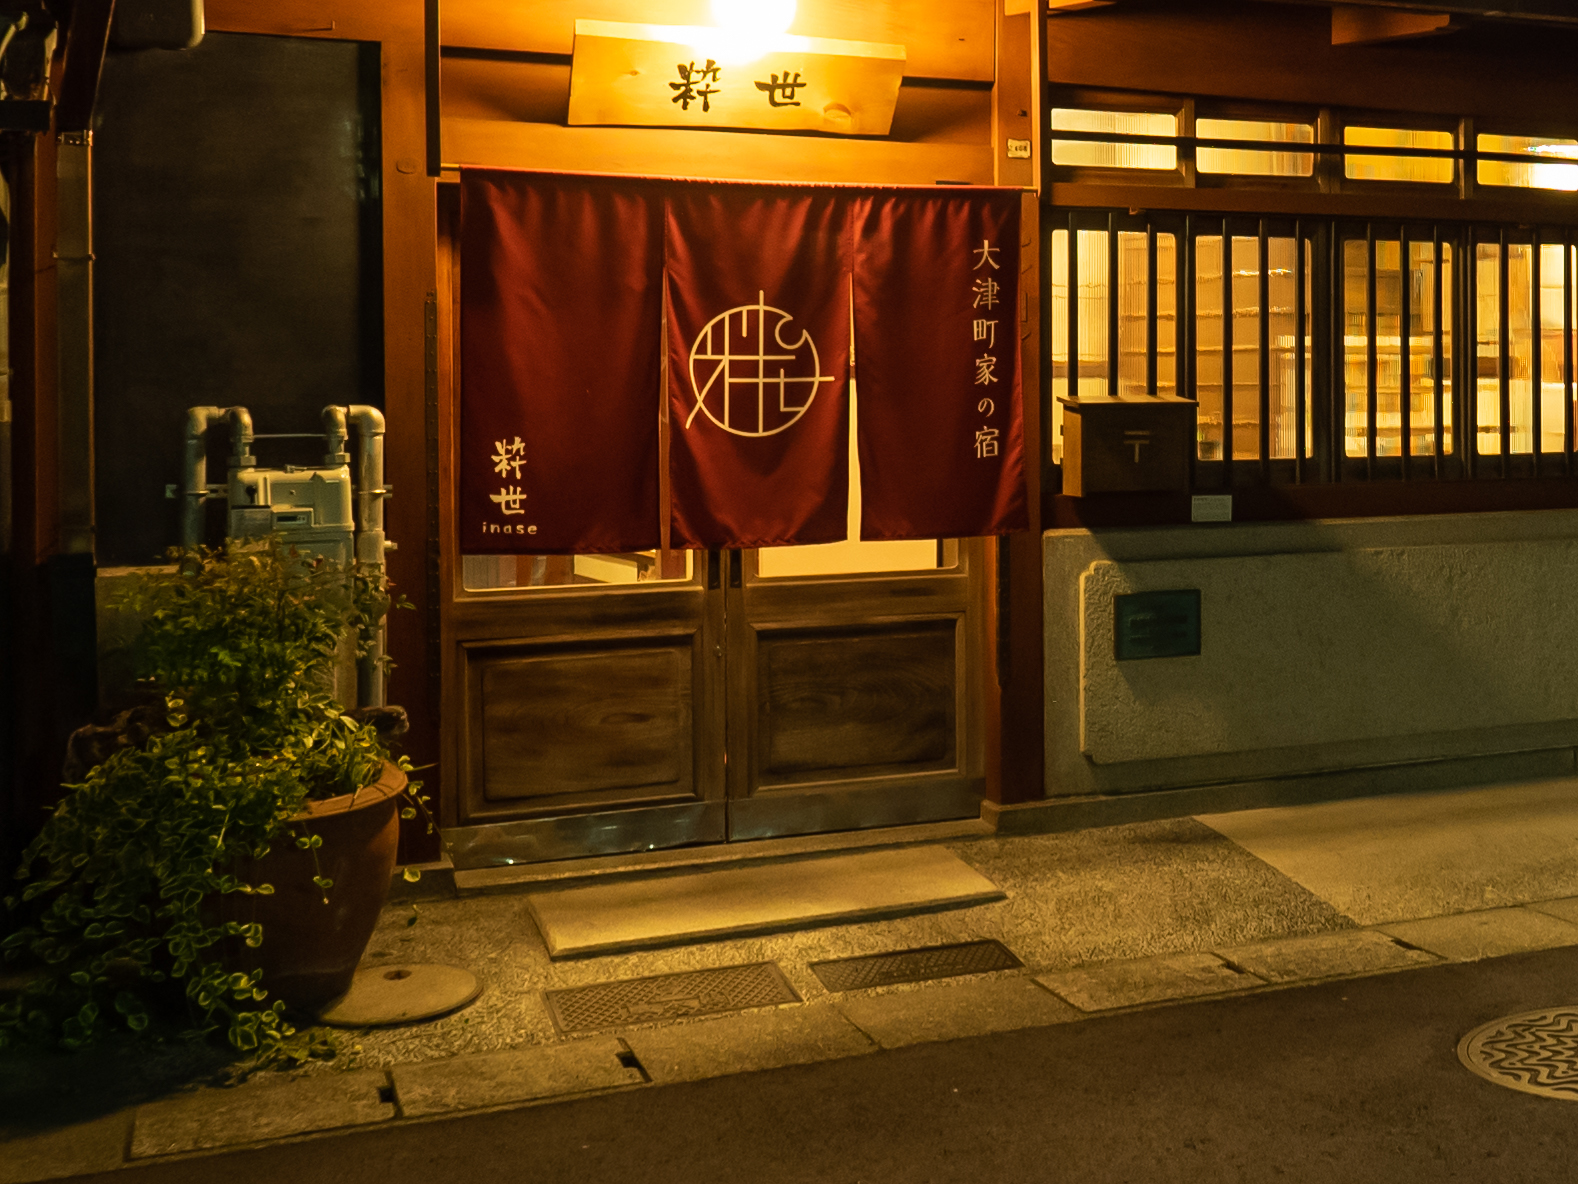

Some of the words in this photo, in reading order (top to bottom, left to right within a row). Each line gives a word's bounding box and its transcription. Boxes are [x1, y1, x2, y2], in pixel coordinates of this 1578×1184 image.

[971, 239, 1000, 459] 大津町家の宿
[482, 521, 538, 535] inase
